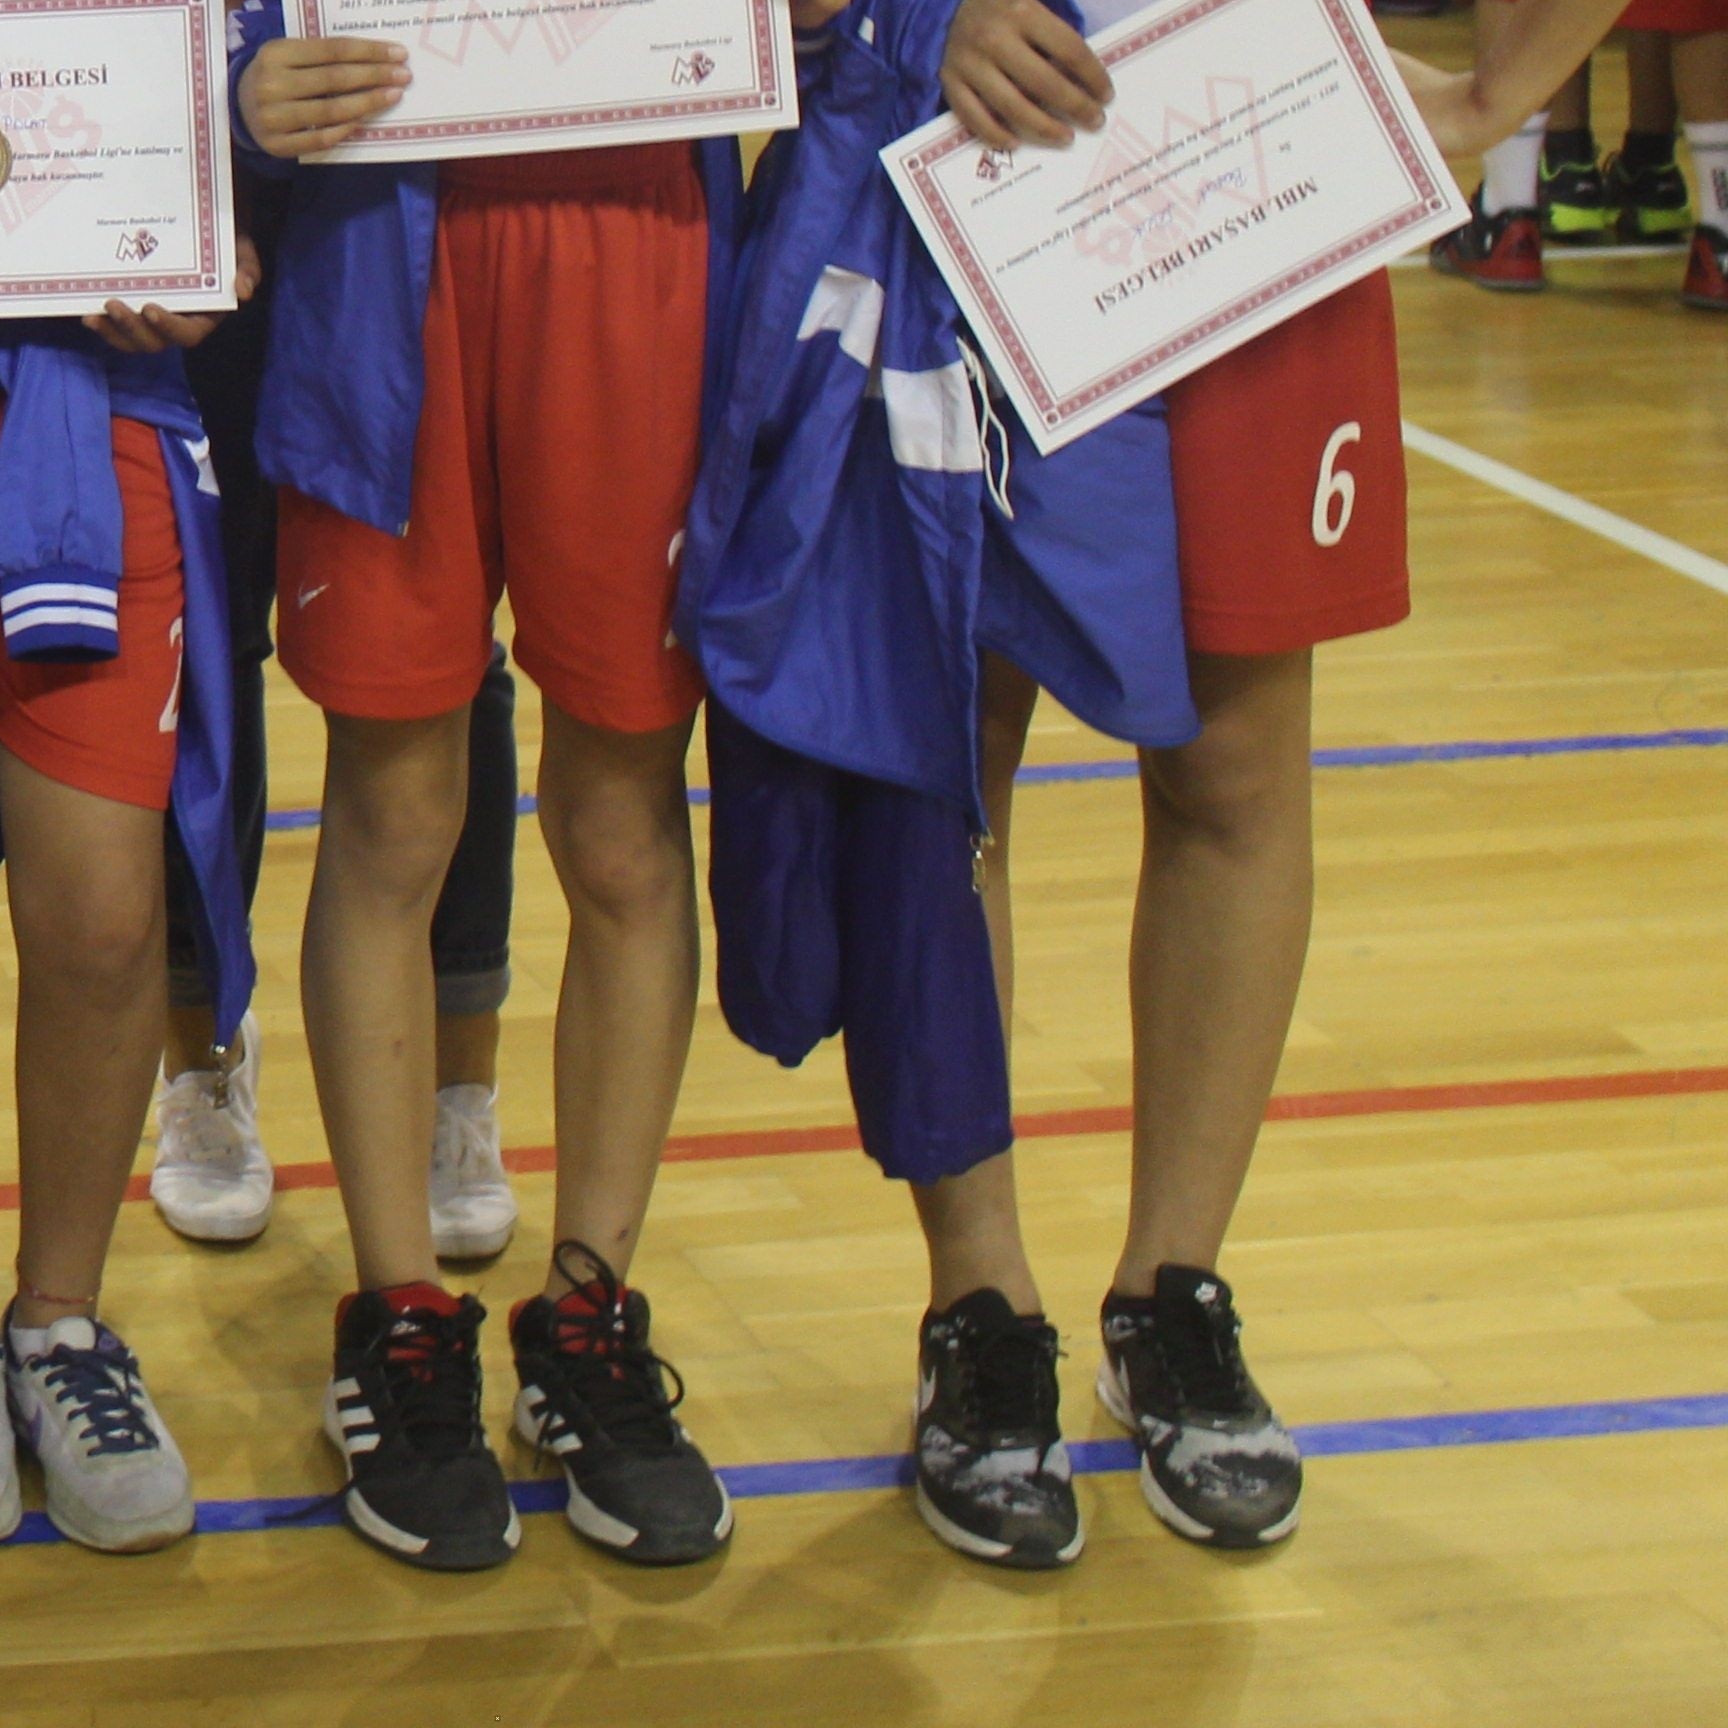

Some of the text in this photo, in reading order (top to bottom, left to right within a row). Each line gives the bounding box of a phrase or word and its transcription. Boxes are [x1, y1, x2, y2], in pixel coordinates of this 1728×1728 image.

[9, 63, 109, 89] BELGESİ
[1266, 176, 1320, 215] MBL
[1186, 203, 1267, 259] BAŞARI
[1093, 253, 1186, 315] BELGESİ
[1310, 420, 1362, 549] 6
